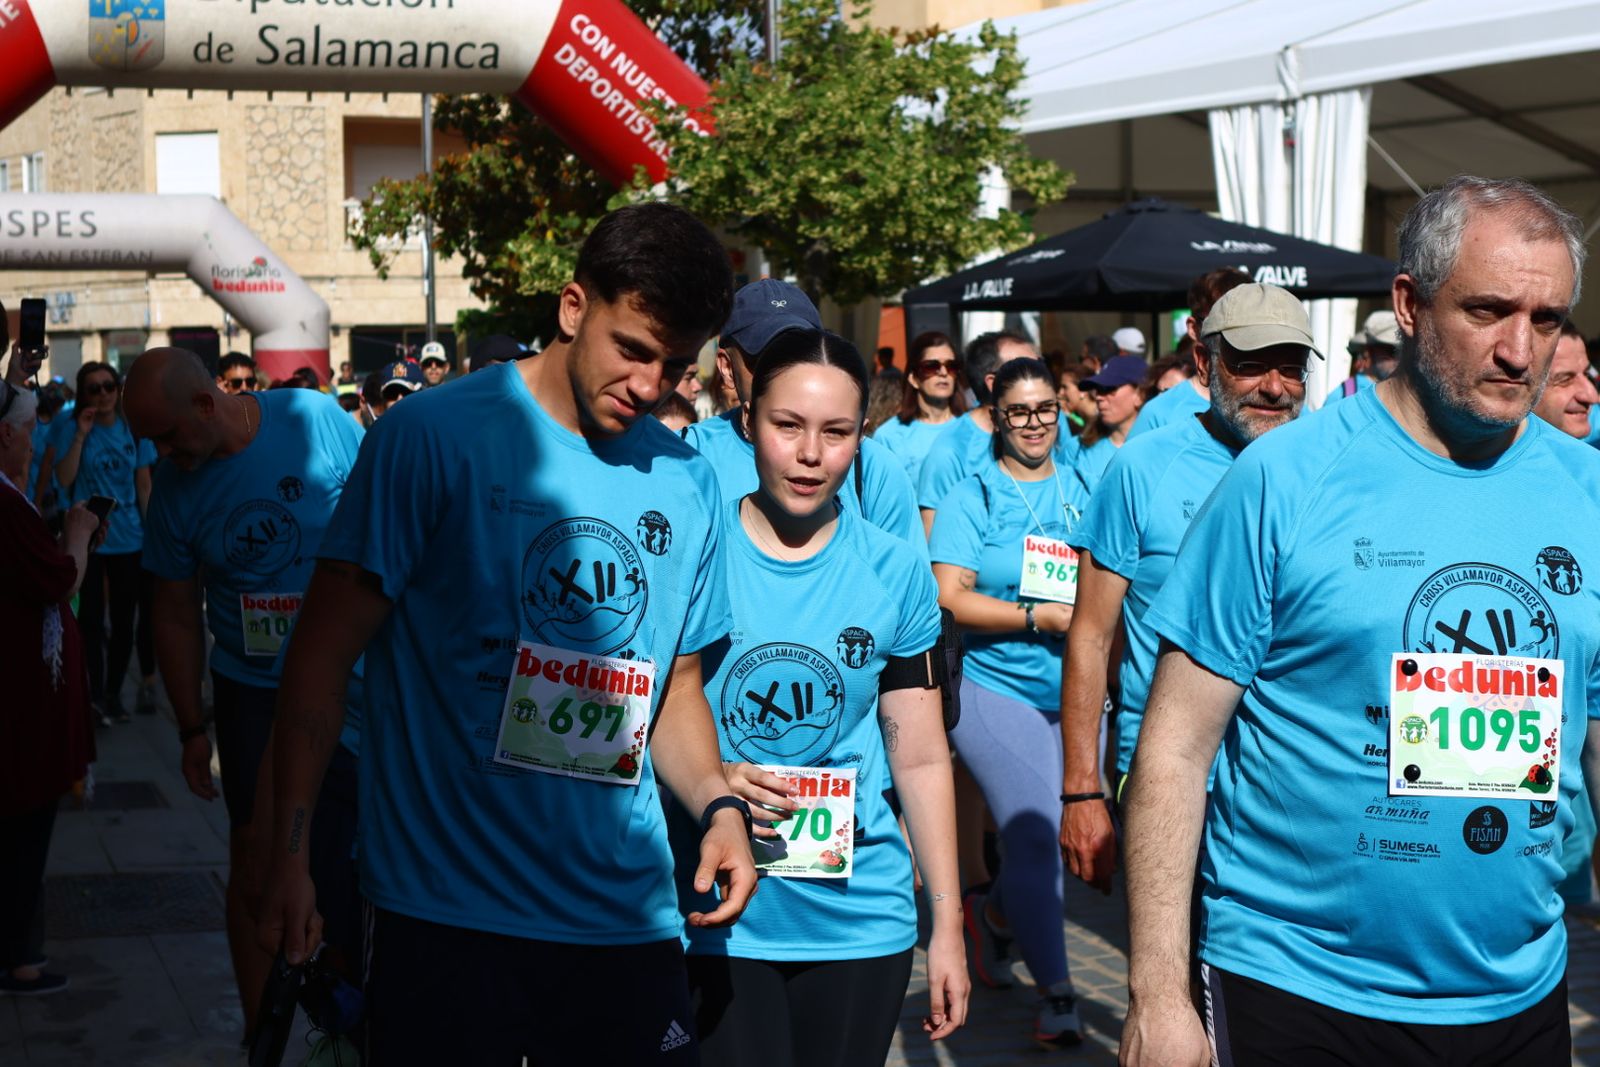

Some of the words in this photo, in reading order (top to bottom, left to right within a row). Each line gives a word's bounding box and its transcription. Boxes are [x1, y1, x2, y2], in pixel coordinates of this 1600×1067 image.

[193, 31, 234, 64] de
[256, 24, 500, 69] Salamanca
[570, 14, 616, 60] CON
[554, 43, 674, 162] DEPORTISTA
[0, 210, 97, 238] SPES
[212, 278, 286, 292] bedunia
[559, 523, 612, 541] VILLAMAYOR
[611, 534, 637, 567] ASPACE
[1377, 558, 1427, 568] Villamayor
[1540, 548, 1571, 559] ASPACE
[549, 558, 616, 605] XII
[1044, 561, 1078, 583] 967
[1419, 583, 1445, 608] CROSS
[1443, 569, 1504, 586] VILLAMAYOR
[1505, 578, 1540, 610] ASPACE
[1435, 609, 1517, 655] XII
[516, 647, 649, 697] bedunia
[734, 657, 757, 680] CROSS
[756, 647, 810, 662] VILLAMAYOR
[810, 656, 837, 683] ASPACE
[1396, 659, 1558, 698] bedunia
[549, 698, 626, 742] 697
[745, 680, 814, 724] XII
[1430, 706, 1541, 754] 1095
[1373, 797, 1423, 808] AUTOCARES
[768, 807, 833, 842] 70
[1379, 839, 1441, 854] SUMESAL
